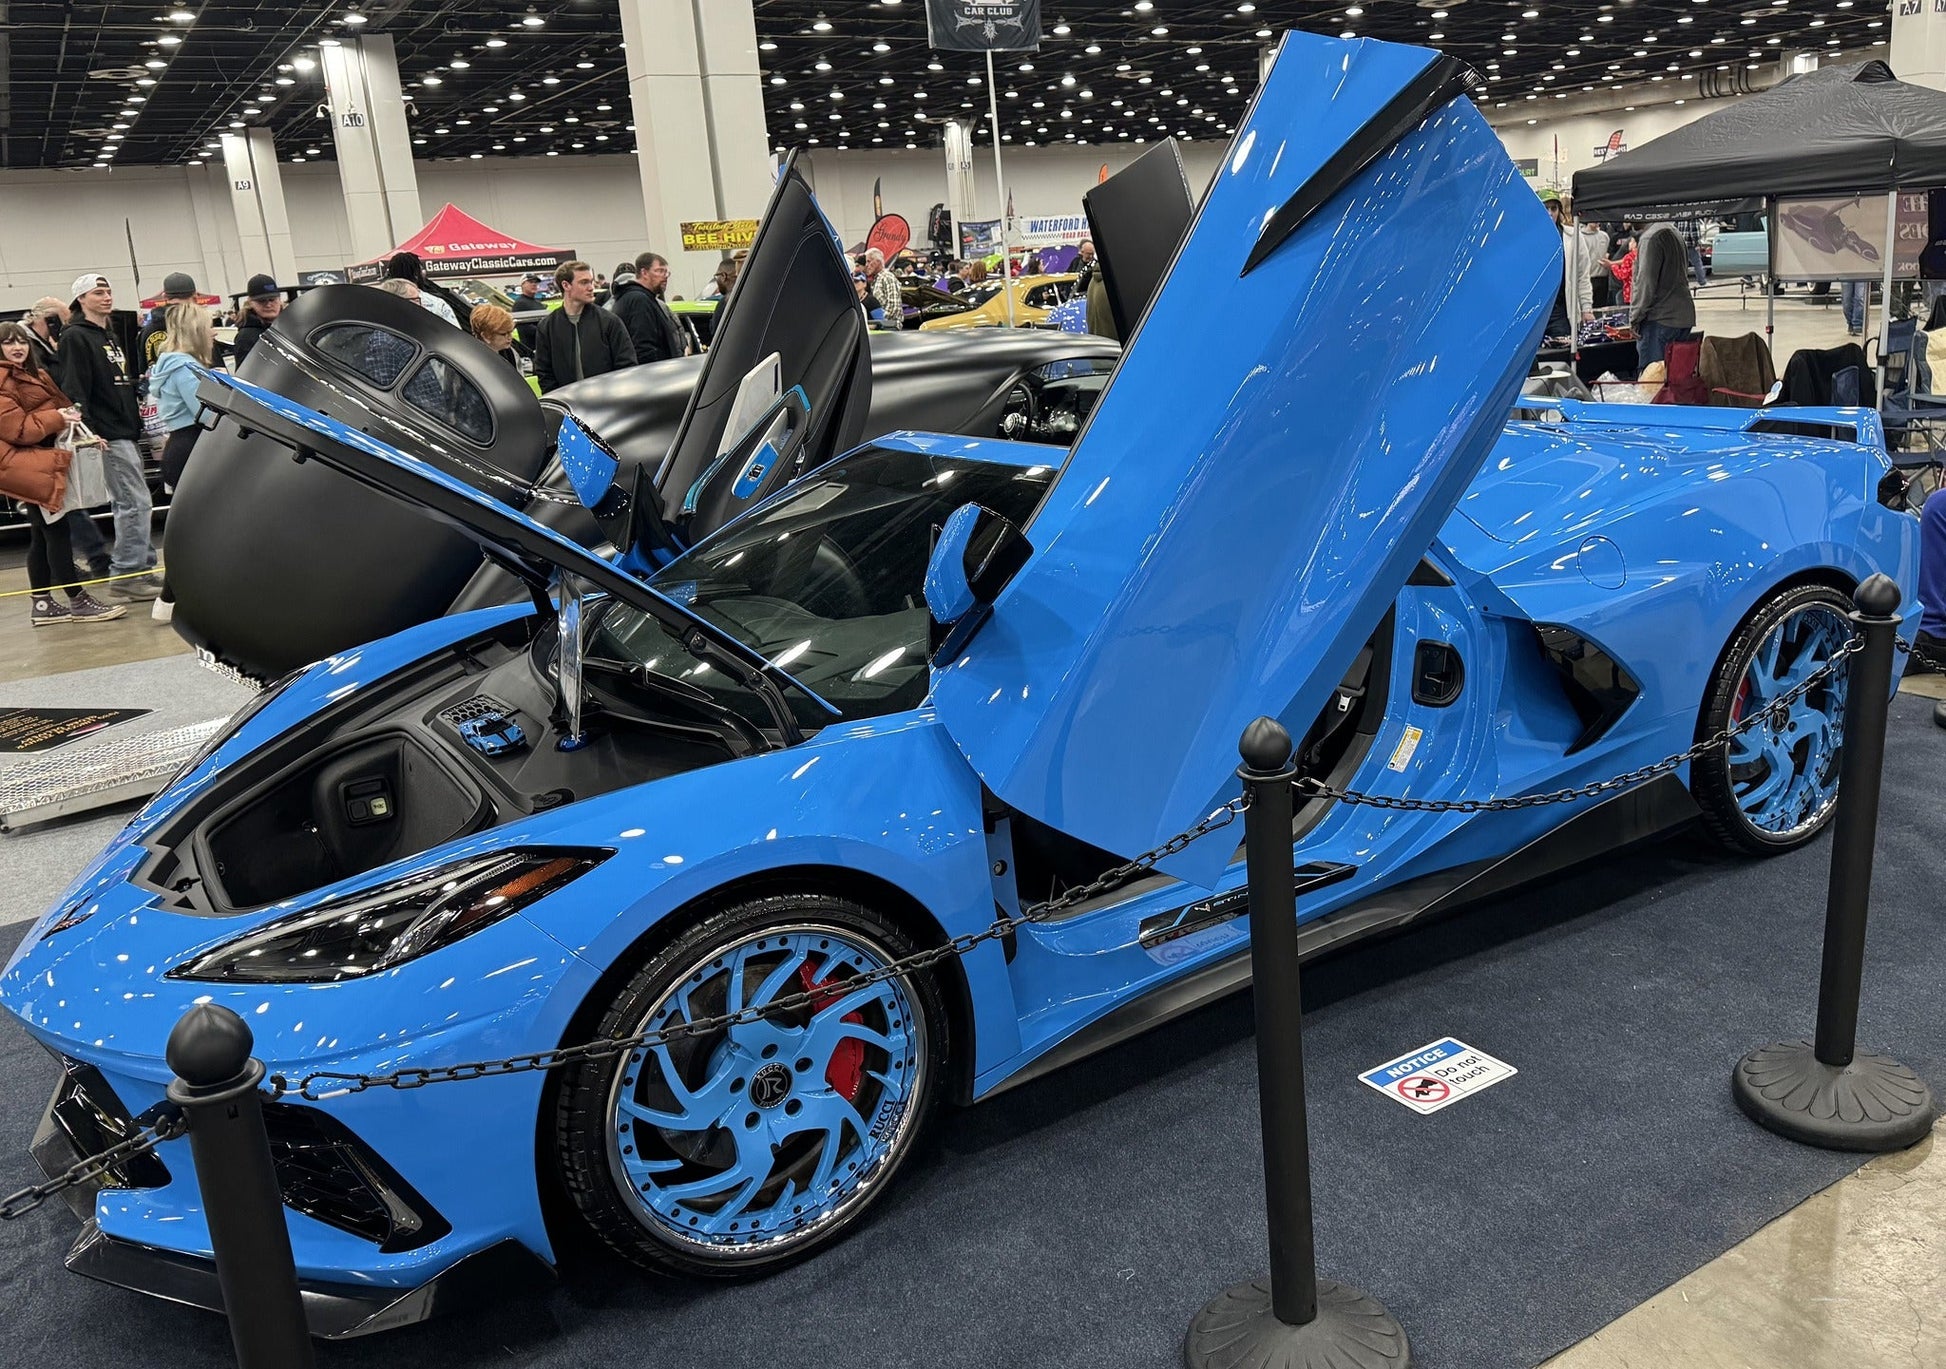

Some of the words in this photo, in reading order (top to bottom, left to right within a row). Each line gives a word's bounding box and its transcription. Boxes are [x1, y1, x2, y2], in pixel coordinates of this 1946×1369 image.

[964, 7, 985, 15] CAR
[987, 7, 1013, 15] CLUB
[1903, 0, 1919, 15] A7
[343, 114, 364, 126] A10
[237, 181, 249, 190] A9
[1030, 218, 1080, 233] WATERFORD
[683, 233, 718, 245] BEE
[873, 222, 907, 249] Grundy
[448, 242, 517, 251] Gateway
[425, 256, 557, 272] GatewayClassicCars.com
[1213, 891, 1249, 907] STIN
[1386, 1048, 1448, 1079] NOTICE
[1434, 1067, 1457, 1078] Do
[1457, 1055, 1483, 1069] not
[756, 1065, 785, 1080] RUCCI
[1449, 1065, 1491, 1085] touch
[868, 1099, 896, 1139] RUCCI
